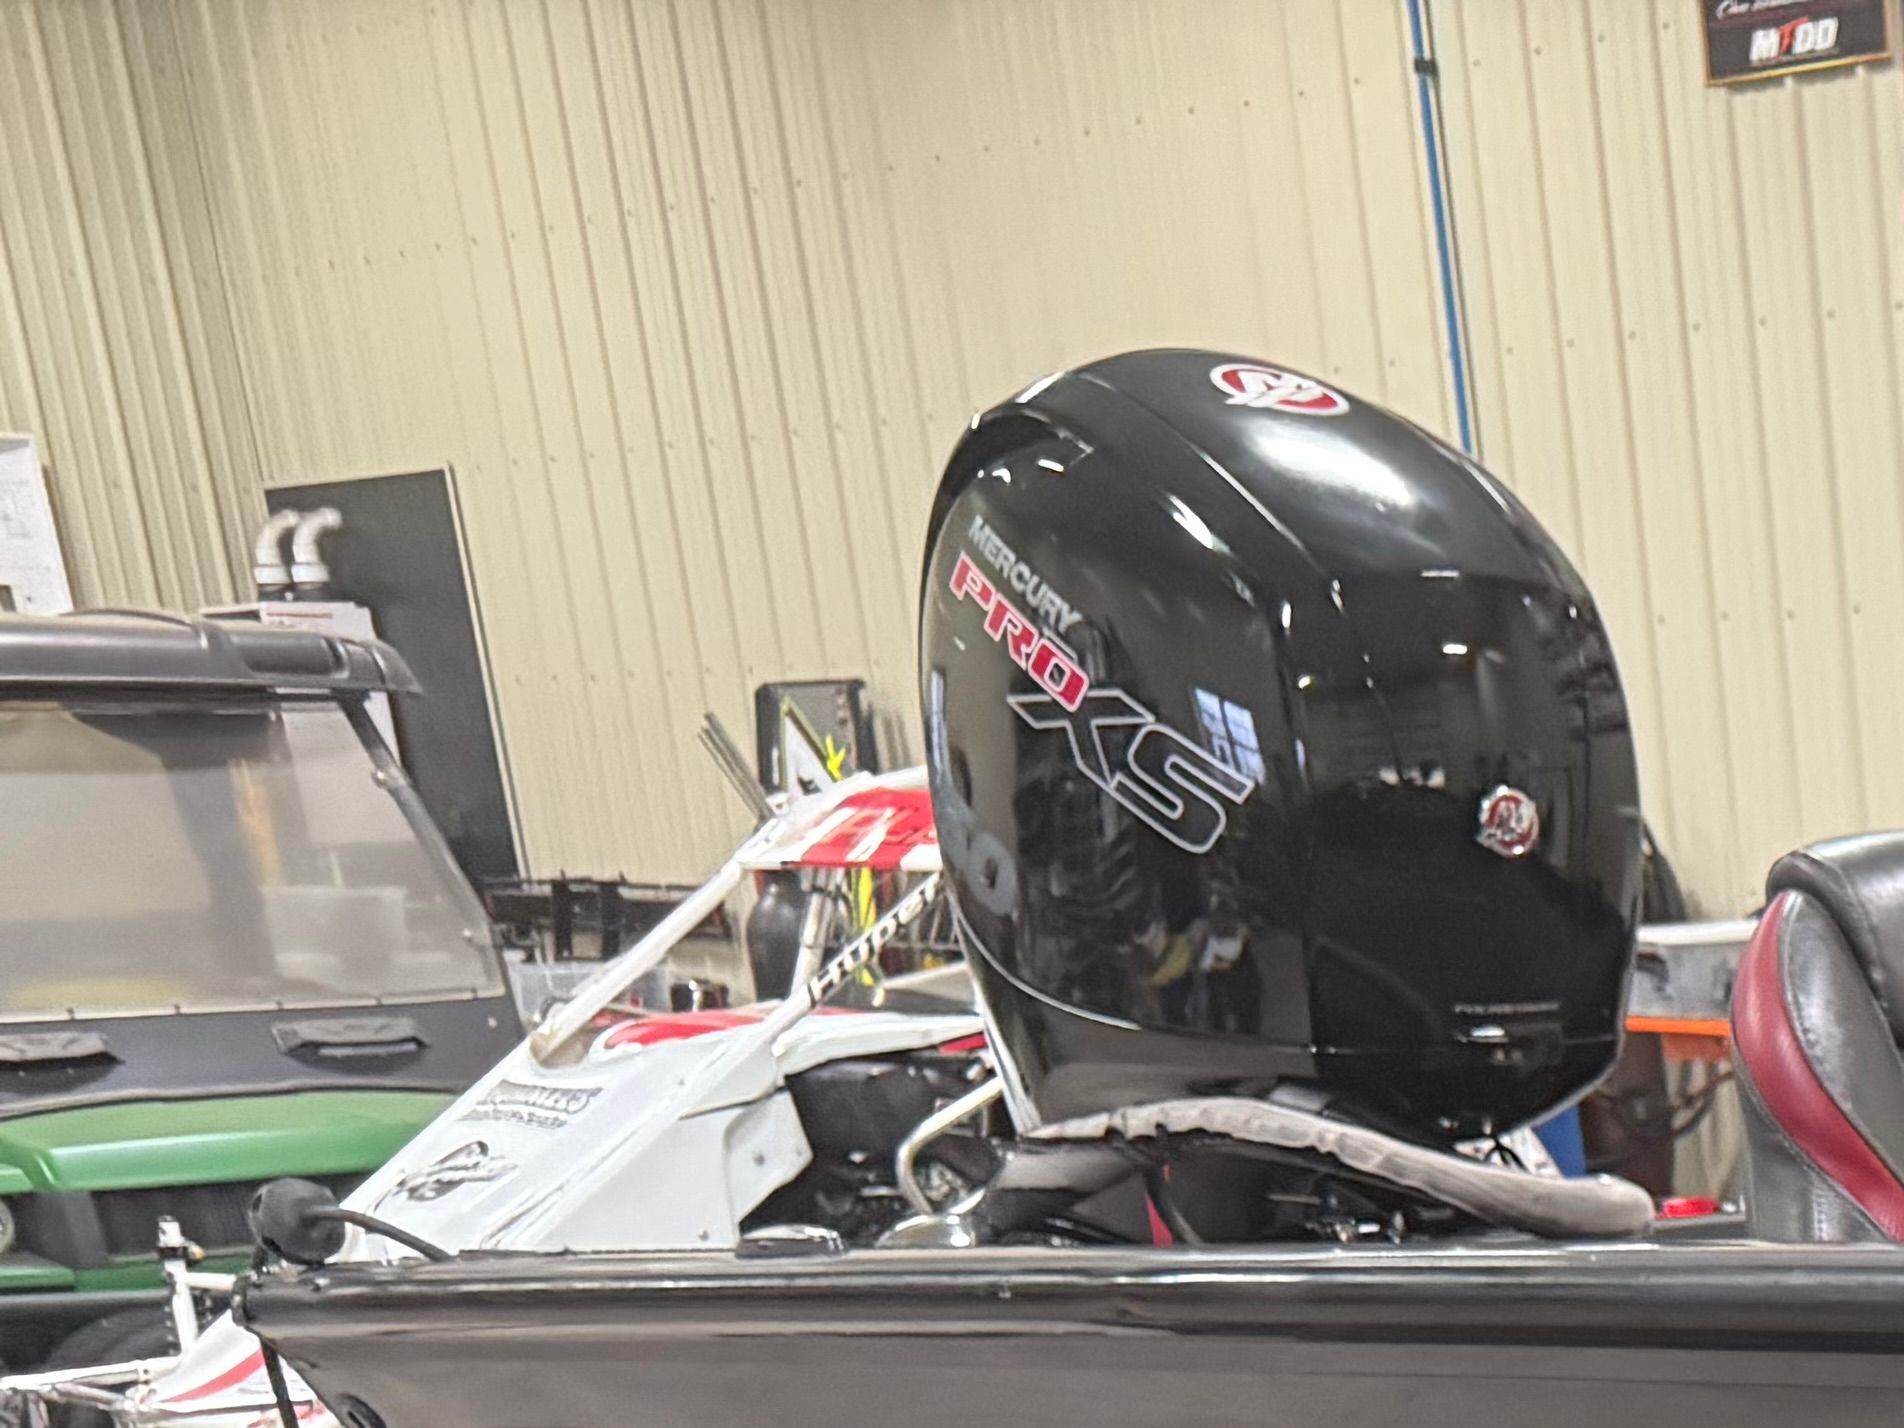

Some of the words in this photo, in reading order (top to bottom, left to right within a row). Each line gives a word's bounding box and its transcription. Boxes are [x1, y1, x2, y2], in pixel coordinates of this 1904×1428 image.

[949, 551, 1090, 712] PRO
[969, 515, 1082, 636] MERCURY
[1006, 688, 1256, 854] XS
